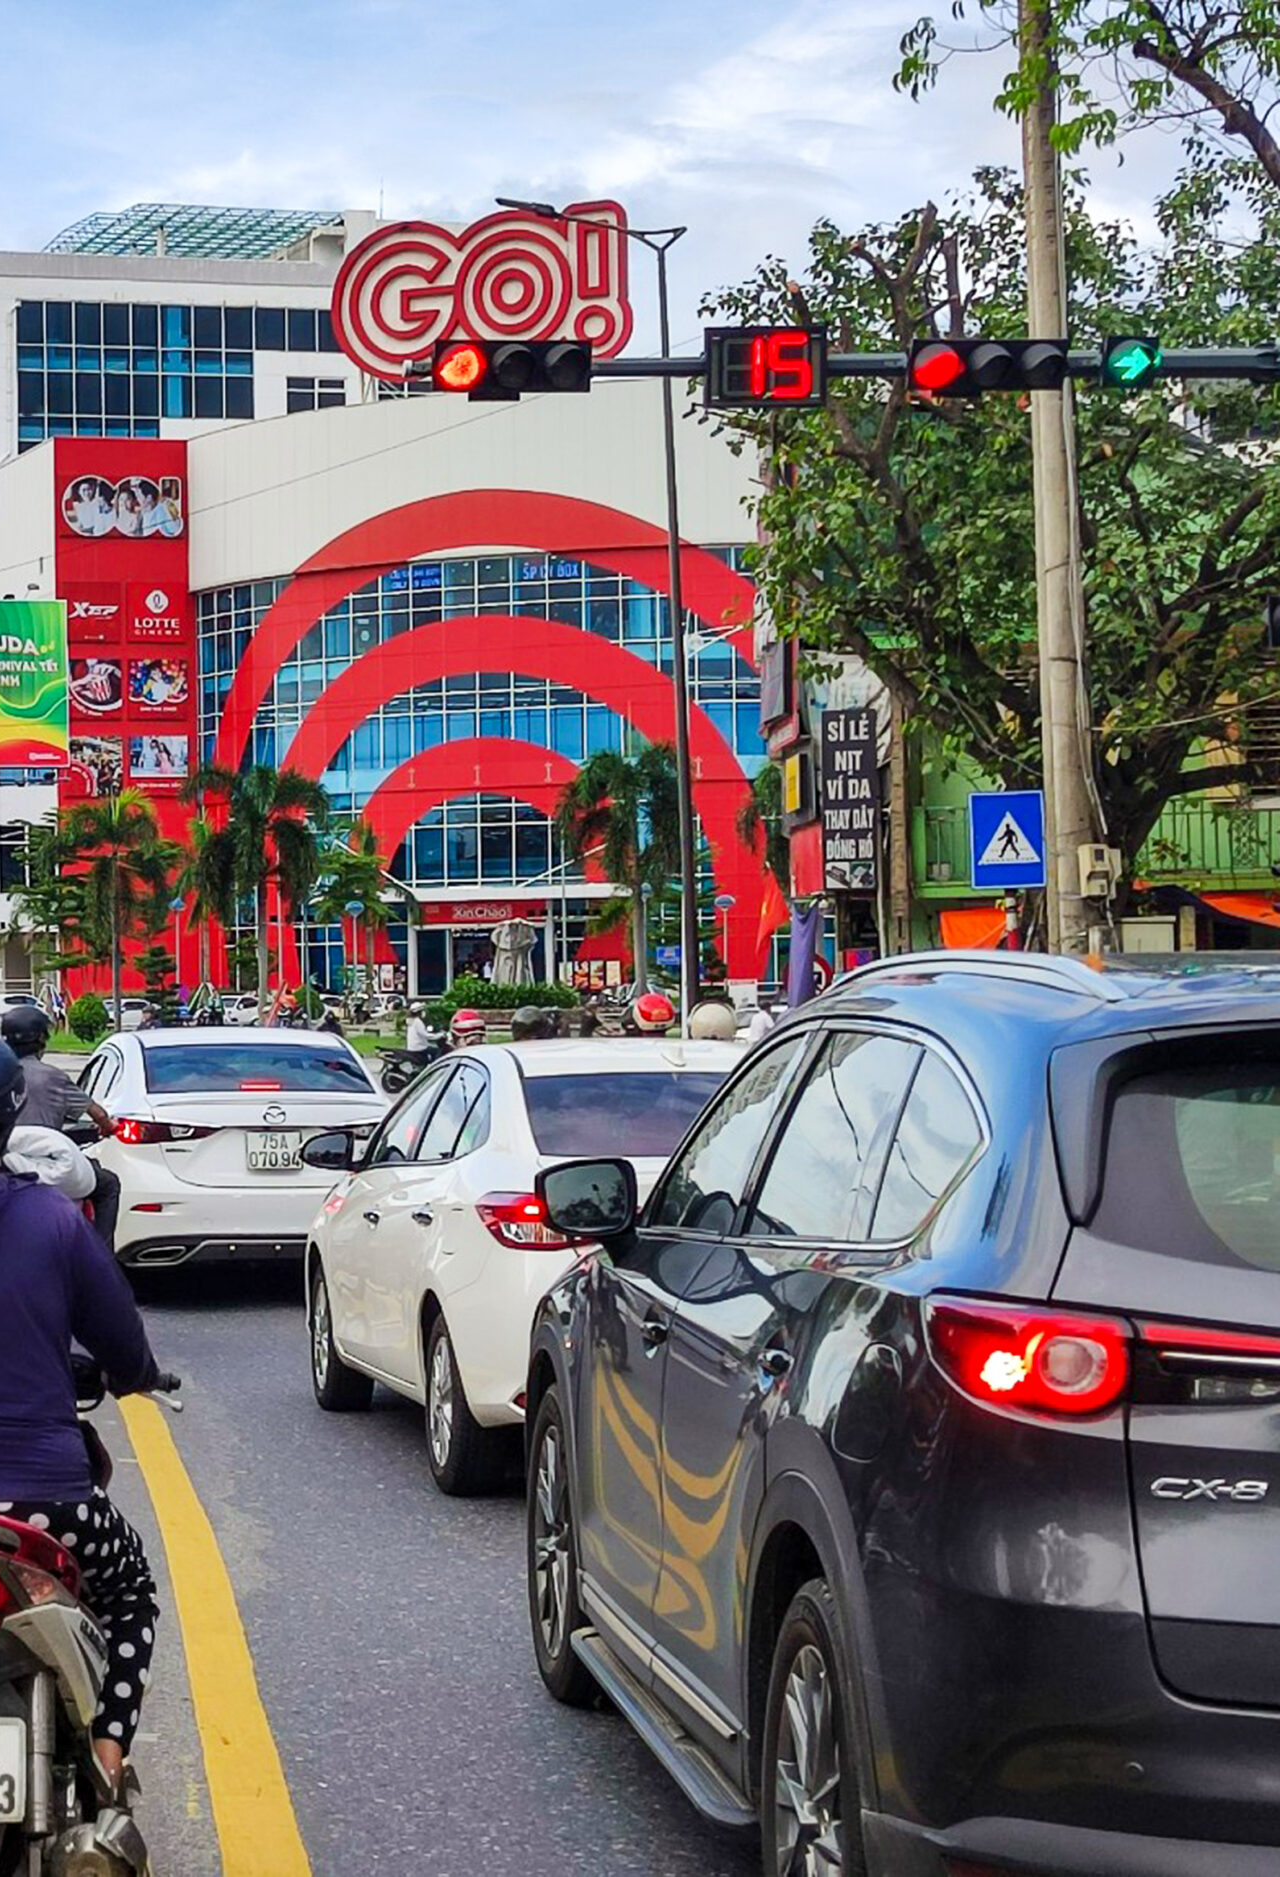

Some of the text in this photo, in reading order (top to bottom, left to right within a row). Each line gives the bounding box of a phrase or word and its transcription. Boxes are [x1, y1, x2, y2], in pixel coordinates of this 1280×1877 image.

[331, 200, 632, 382] GO!
[751, 332, 813, 399] 15
[134, 618, 180, 629] LOTTE
[849, 713, 869, 740] LẺ
[834, 750, 863, 775] NỊT
[827, 774, 871, 800] VÍ DA
[825, 808, 850, 830] THAY
[258, 1132, 289, 1150] 75A
[248, 1152, 301, 1168] 070.94
[1150, 1476, 1269, 1501] CX-8
